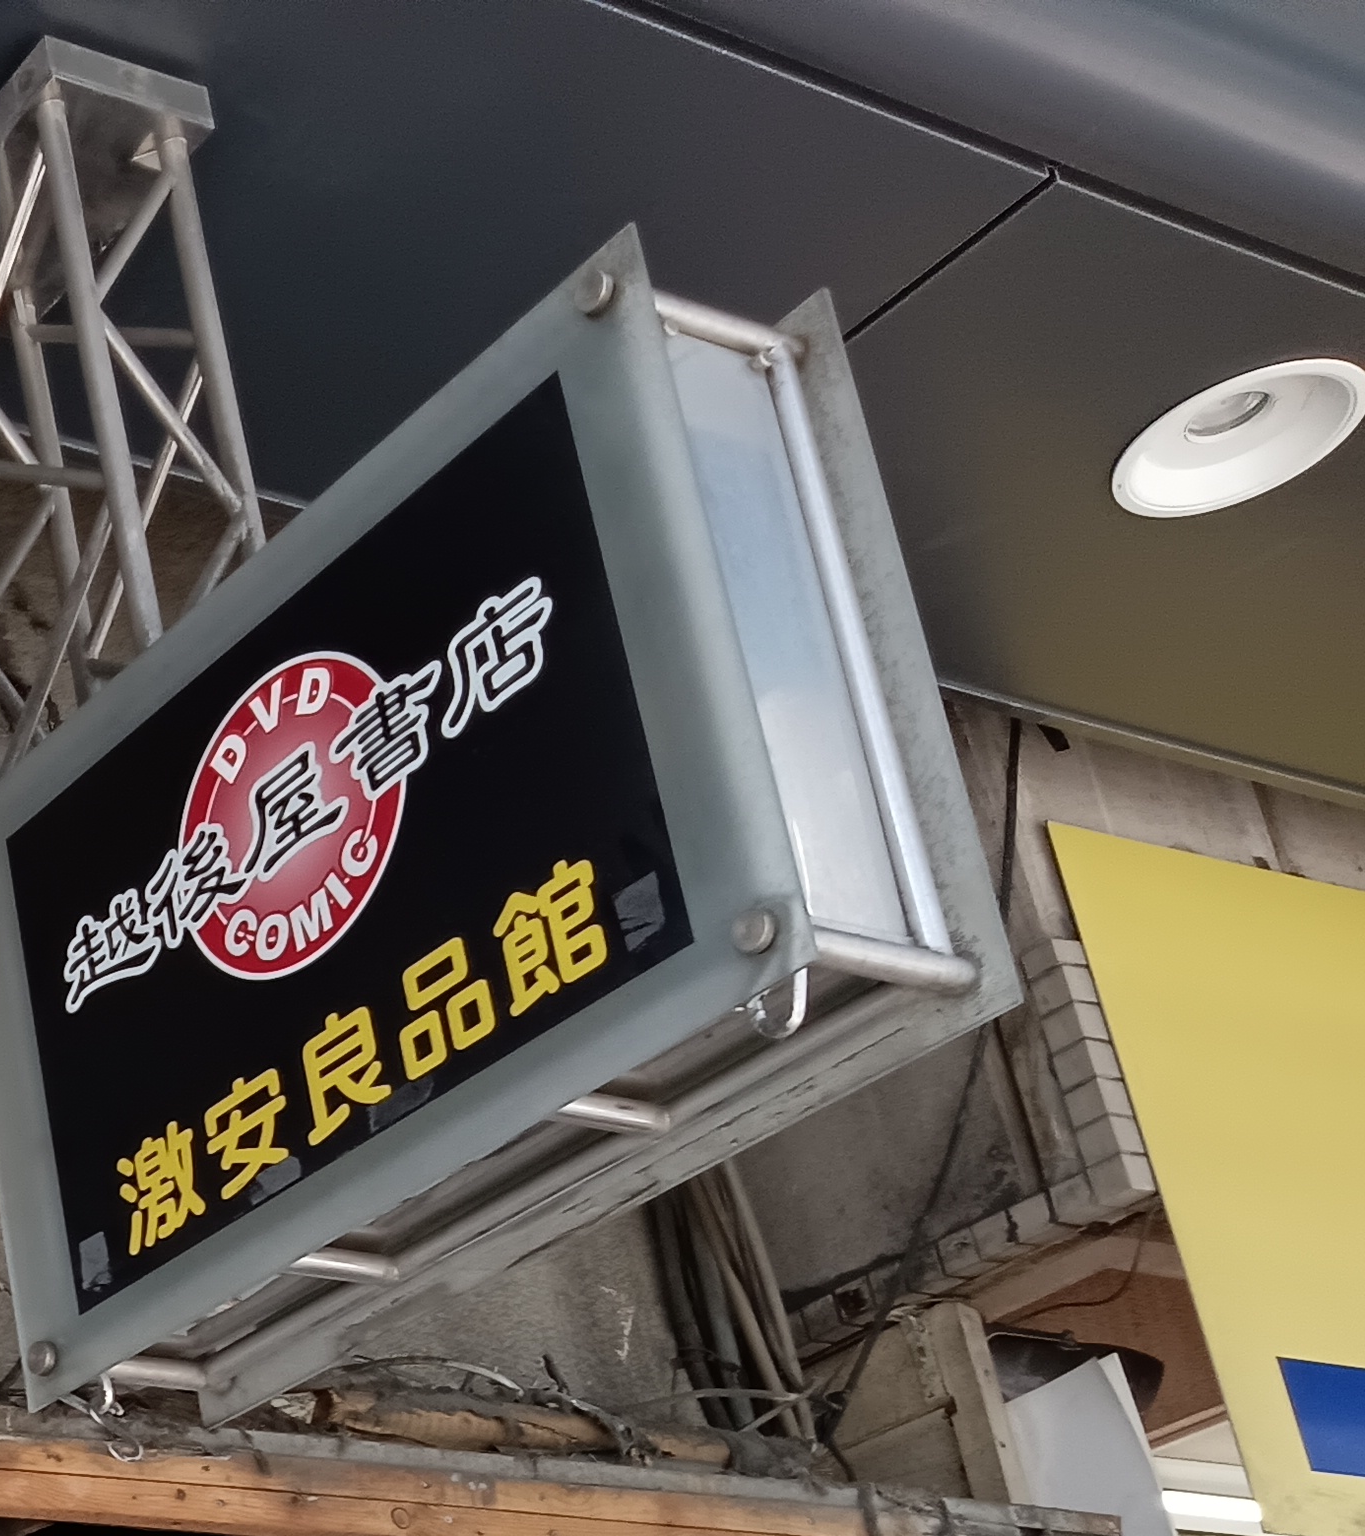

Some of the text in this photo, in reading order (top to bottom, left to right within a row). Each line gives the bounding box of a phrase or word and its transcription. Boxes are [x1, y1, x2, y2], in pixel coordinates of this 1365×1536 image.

[64, 576, 552, 1013] 越後屋書店
[209, 667, 332, 784] DVD
[224, 829, 378, 961] COMIC
[116, 859, 608, 1256] 激安良品館
